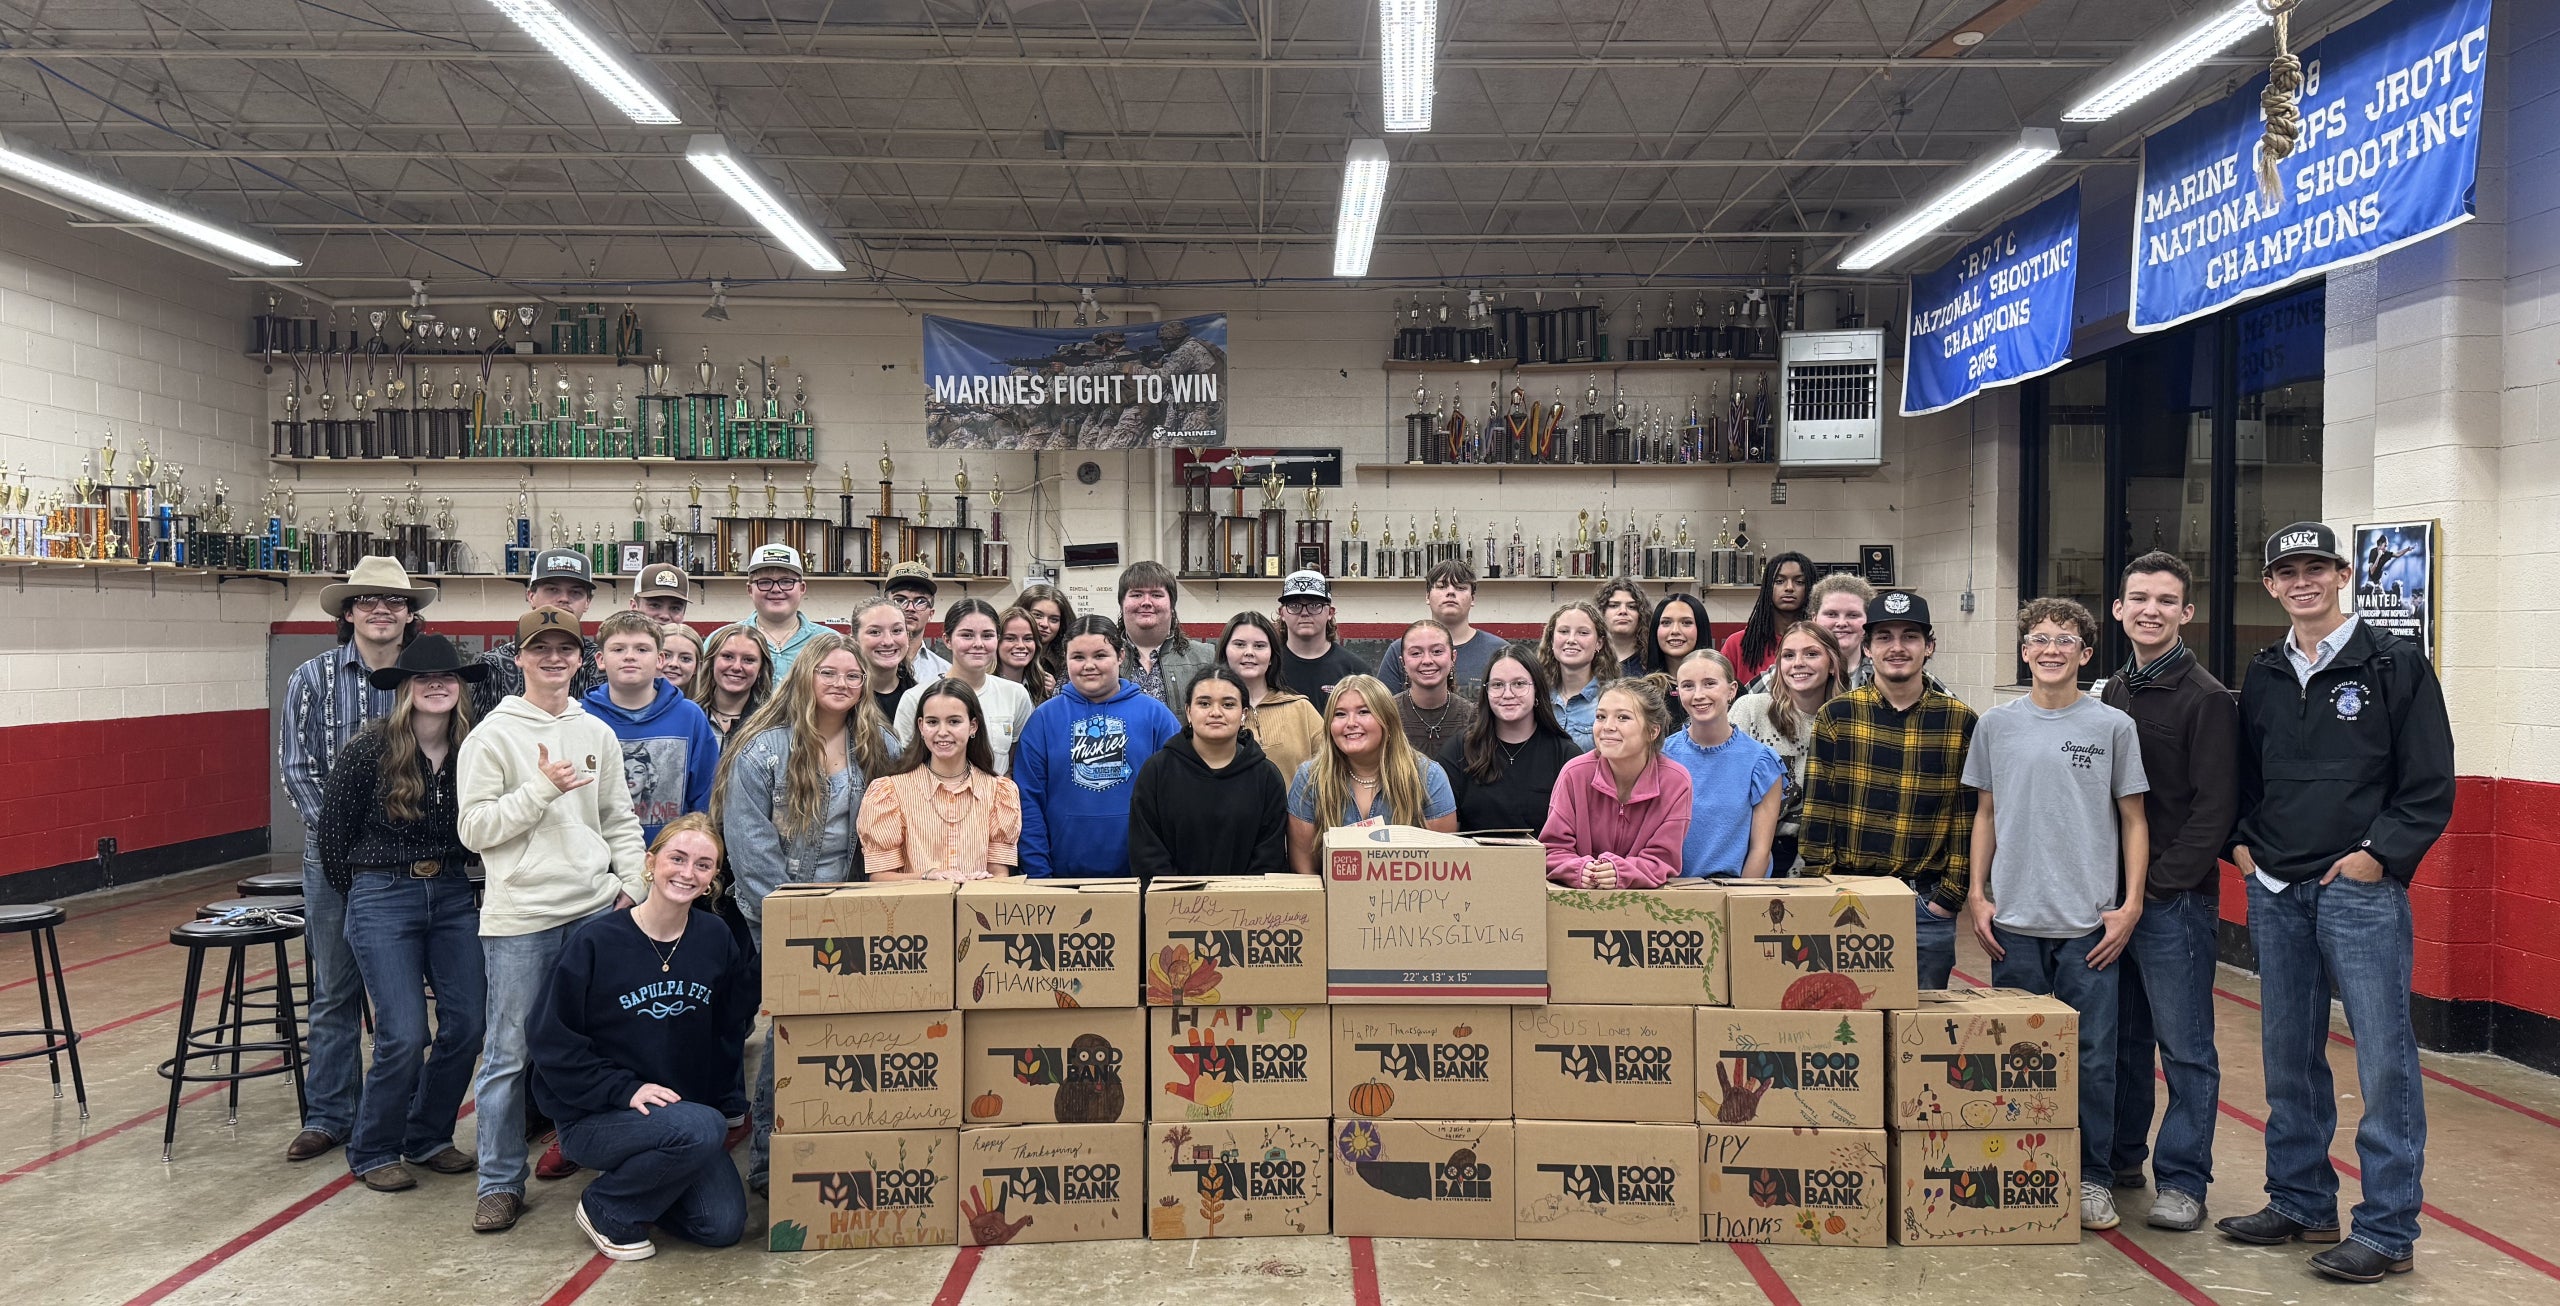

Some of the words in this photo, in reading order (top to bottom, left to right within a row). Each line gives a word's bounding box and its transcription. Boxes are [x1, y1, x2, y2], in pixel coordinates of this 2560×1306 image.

[2144, 154, 2238, 224] MARINE
[2253, 98, 2346, 173] CRPS
[2364, 25, 2485, 122] JROTC
[2148, 191, 2282, 266] NATIONAL
[2296, 90, 2474, 205] SHOOTING
[2206, 192, 2380, 290] CHAMPIONS
[1912, 285, 1982, 336] NATIONAL
[1989, 237, 2072, 300] SHOOTING
[1944, 298, 2030, 359] CHAMPIONS
[936, 374, 1045, 405] MARINES
[1055, 375, 1124, 405] FIGHT
[1132, 374, 1162, 404] TO
[1170, 373, 1218, 403] WIN
[1166, 428, 1217, 438] MARINES
[2357, 594, 2401, 607] WANTED:
[1071, 734, 1129, 759] Huskies
[2061, 741, 2106, 756] Sapulpa
[2072, 754, 2092, 764] FFA
[1368, 850, 1400, 859] HEAVY
[1403, 850, 1429, 859] DUTY
[1336, 864, 1358, 876] GEAR
[1366, 862, 1472, 881] MEDIUM
[1381, 889, 1450, 917] HAPPY
[996, 902, 1056, 926] HAPPY
[870, 935, 928, 953] FOOD
[1059, 932, 1115, 950] FOOD
[1248, 929, 1303, 946] FOOD
[1358, 924, 1524, 951] THANKSGIVING
[1648, 930, 1704, 948] FOOD
[1837, 934, 1894, 952] FOOD
[870, 953, 927, 971] BANK
[1059, 950, 1114, 968] BANK
[1248, 947, 1302, 964] BANK
[1648, 947, 1704, 965] BANK
[1837, 952, 1894, 969] BANK
[1403, 972, 1419, 982] 22"
[1432, 972, 1446, 982] 13"
[1457, 972, 1472, 982] 15"
[618, 980, 684, 1010] SAPULPA
[688, 982, 712, 1004] FFA
[1171, 1006, 1307, 1039] HAPPY
[807, 1023, 921, 1051] happy
[881, 1052, 938, 1070] FOOD
[1252, 1044, 1308, 1062] FOOD
[1434, 1044, 1489, 1061] FOOD
[1616, 1046, 1672, 1064] FOOD
[1802, 1052, 1860, 1070] FOOD
[881, 1070, 938, 1088] BANK
[1067, 1065, 1122, 1082] BANK
[1252, 1061, 1307, 1079] BANK
[1434, 1061, 1489, 1079] BANK
[1616, 1063, 1672, 1081] BANK
[1802, 1070, 1859, 1087] BANK
[790, 1098, 958, 1128] Thanksgiving
[1012, 1143, 1082, 1160] Thanksgiving
[876, 1169, 935, 1188] FOOD
[1064, 1164, 1120, 1182] FOOD
[1251, 1161, 1306, 1179] FOOD
[1618, 1166, 1675, 1184] FOOD
[1805, 1170, 1863, 1188] FOOD
[2004, 1170, 2059, 1187] FOOD
[1064, 1181, 1119, 1200] BANK
[1251, 1178, 1305, 1196] BANK
[1618, 1184, 1674, 1202] BANK
[2004, 1187, 2058, 1205] BANK
[877, 1187, 934, 1206] BANK
[1805, 1188, 1862, 1205] BANK
[830, 1210, 907, 1234] HAPPY
[1700, 1212, 1782, 1238] Thanks
